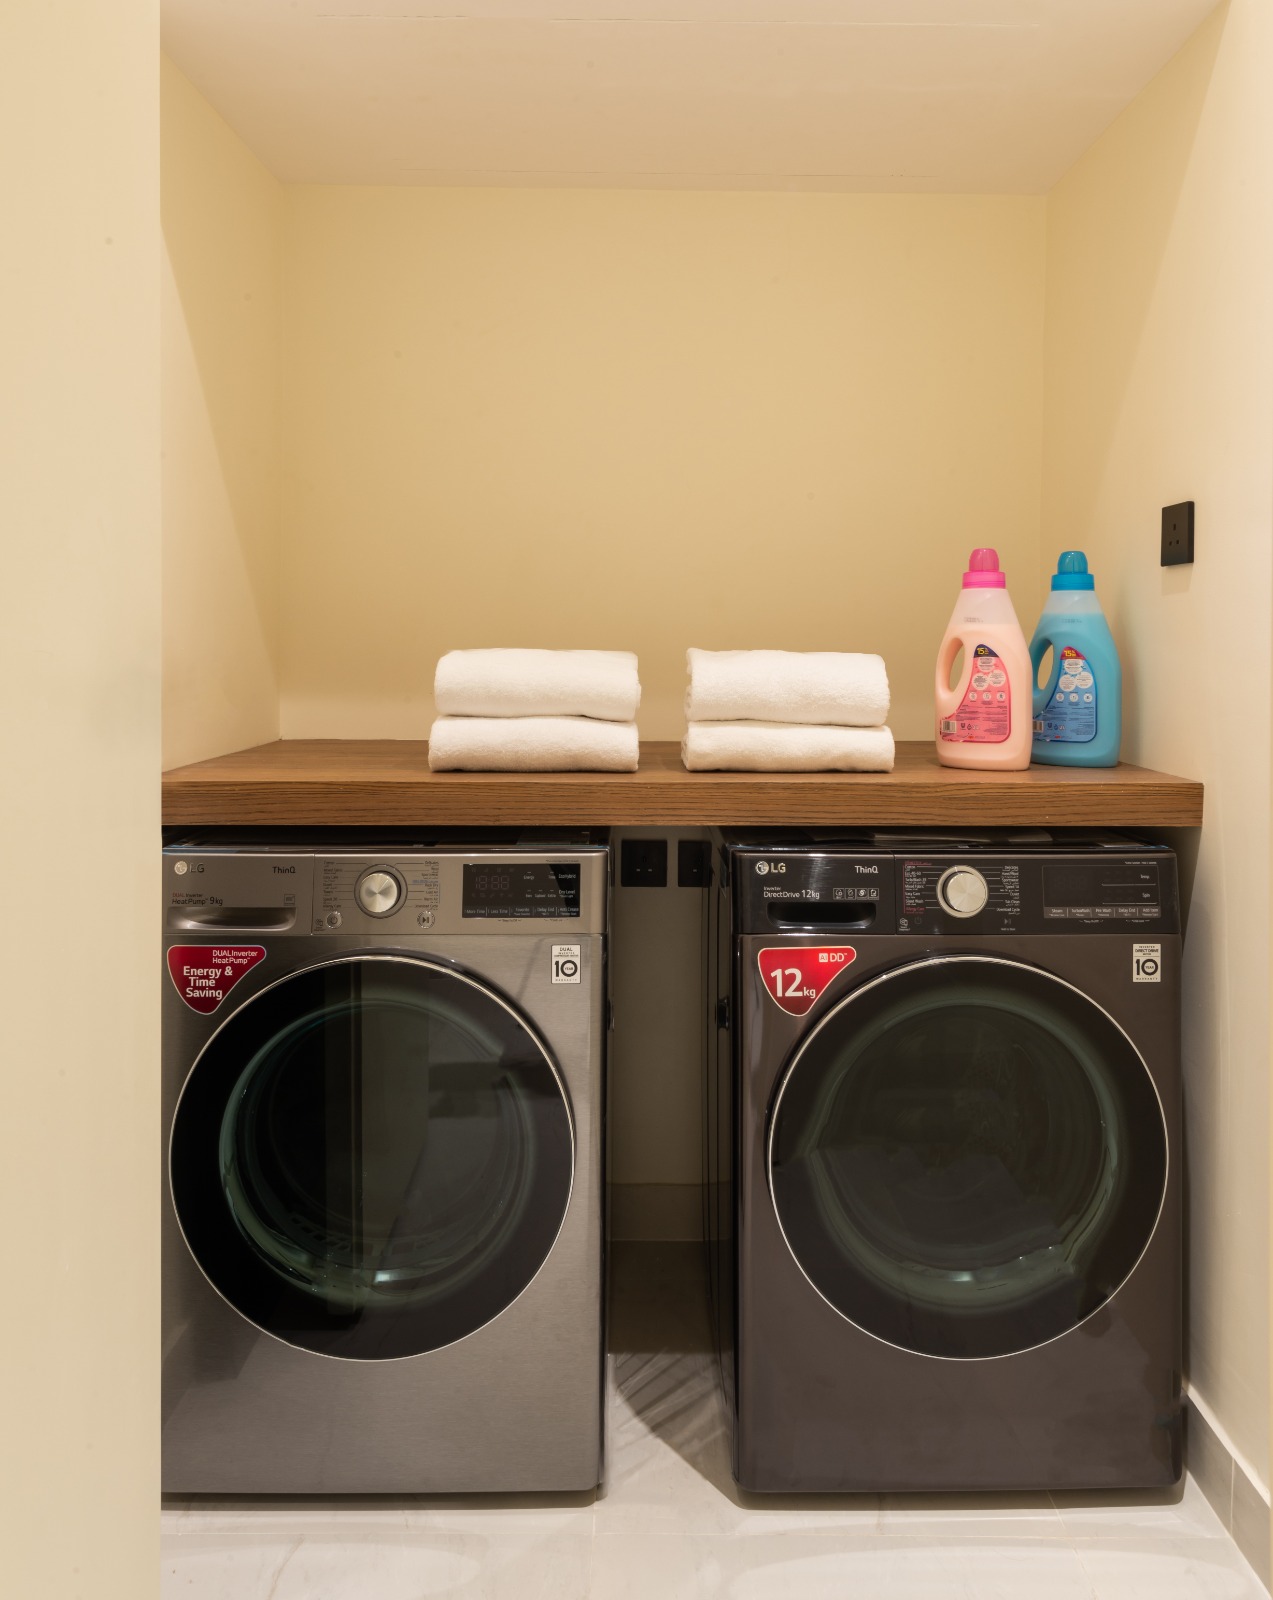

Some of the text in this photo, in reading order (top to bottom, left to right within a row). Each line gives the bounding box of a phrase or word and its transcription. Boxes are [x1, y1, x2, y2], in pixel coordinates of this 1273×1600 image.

[189, 863, 205, 873] LG
[272, 866, 296, 874] ThinQ
[770, 863, 786, 873] LG
[854, 865, 879, 874] ThinQ
[801, 889, 820, 899] 12kg
[183, 965, 233, 979] Energy &
[555, 960, 578, 977] 10
[1135, 958, 1159, 976] 10
[188, 976, 216, 987] Time
[185, 987, 223, 1000] Saving
